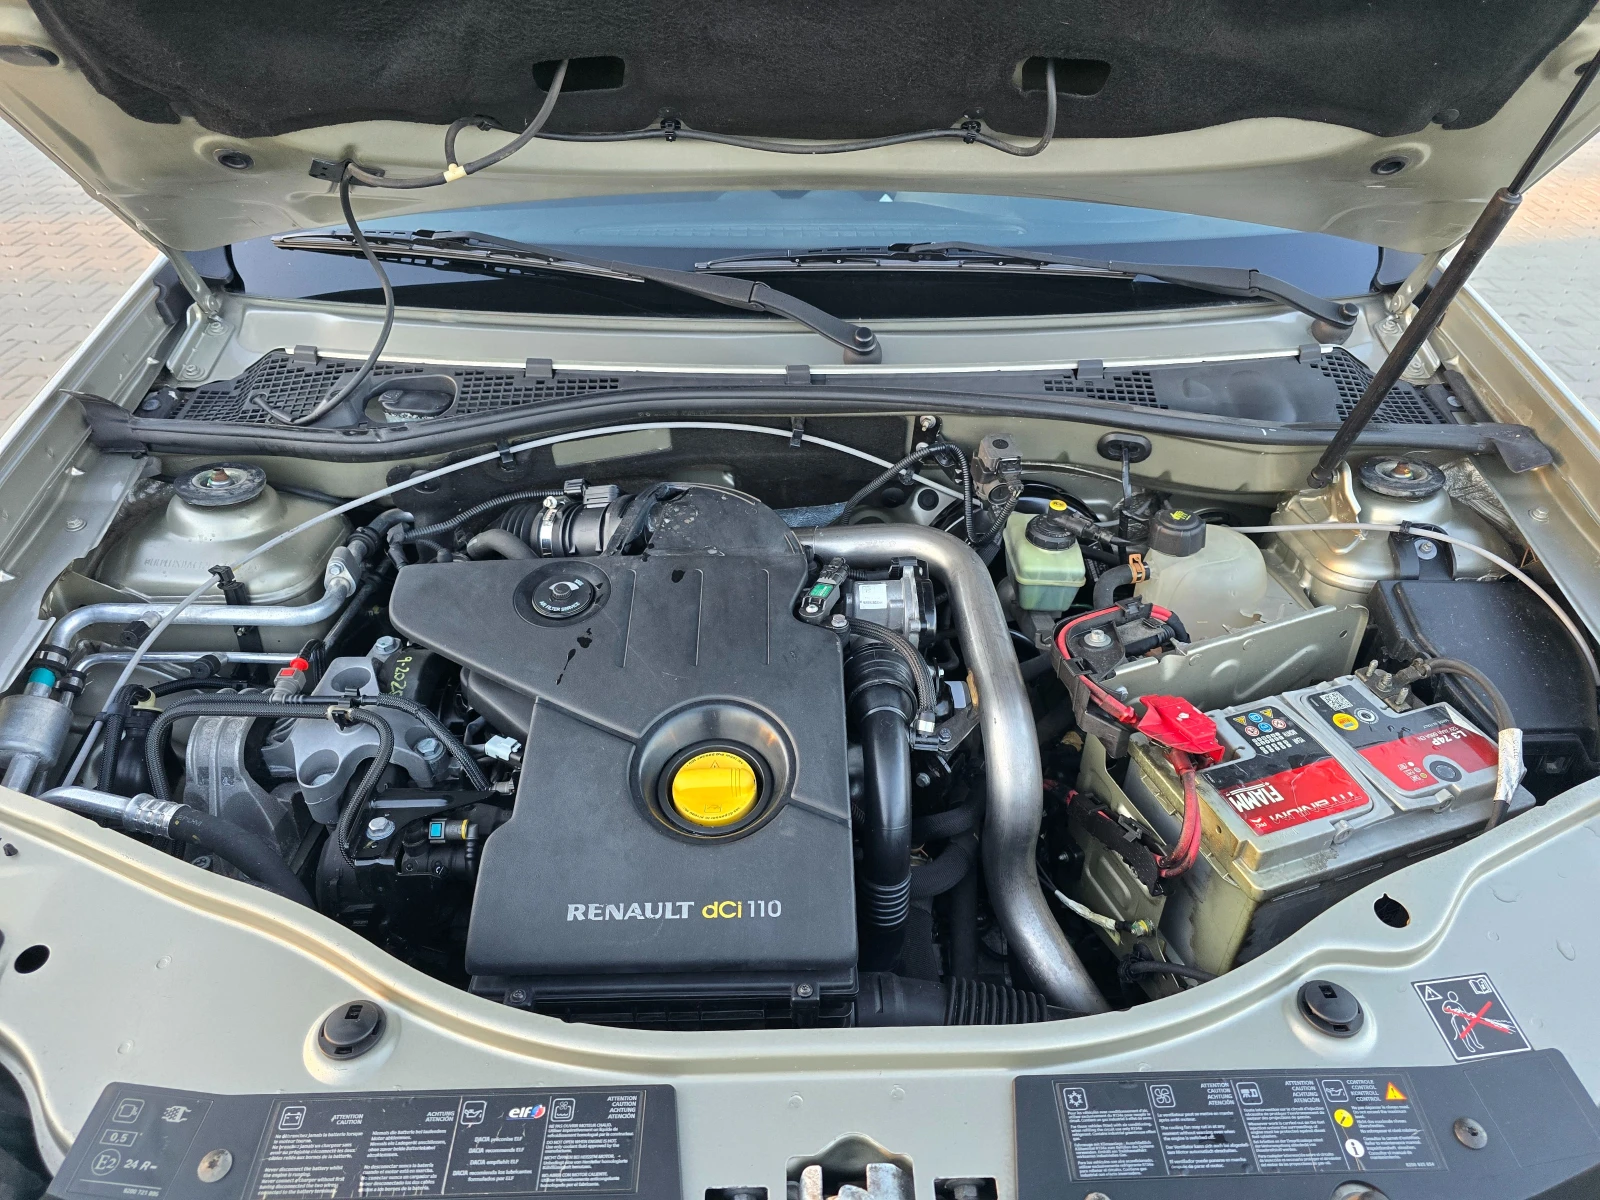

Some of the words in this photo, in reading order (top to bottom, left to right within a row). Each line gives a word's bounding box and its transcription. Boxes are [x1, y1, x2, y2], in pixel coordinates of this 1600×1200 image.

[1432, 734, 1452, 746] 74P
[1452, 730, 1468, 740] L3
[1228, 785, 1284, 812] FIAMM
[566, 901, 695, 921] RENAULT
[702, 900, 742, 919] dCi
[747, 900, 782, 918] 110
[508, 1106, 533, 1118] elf
[110, 1132, 128, 1143] 0,5
[123, 1159, 139, 1170] 24
